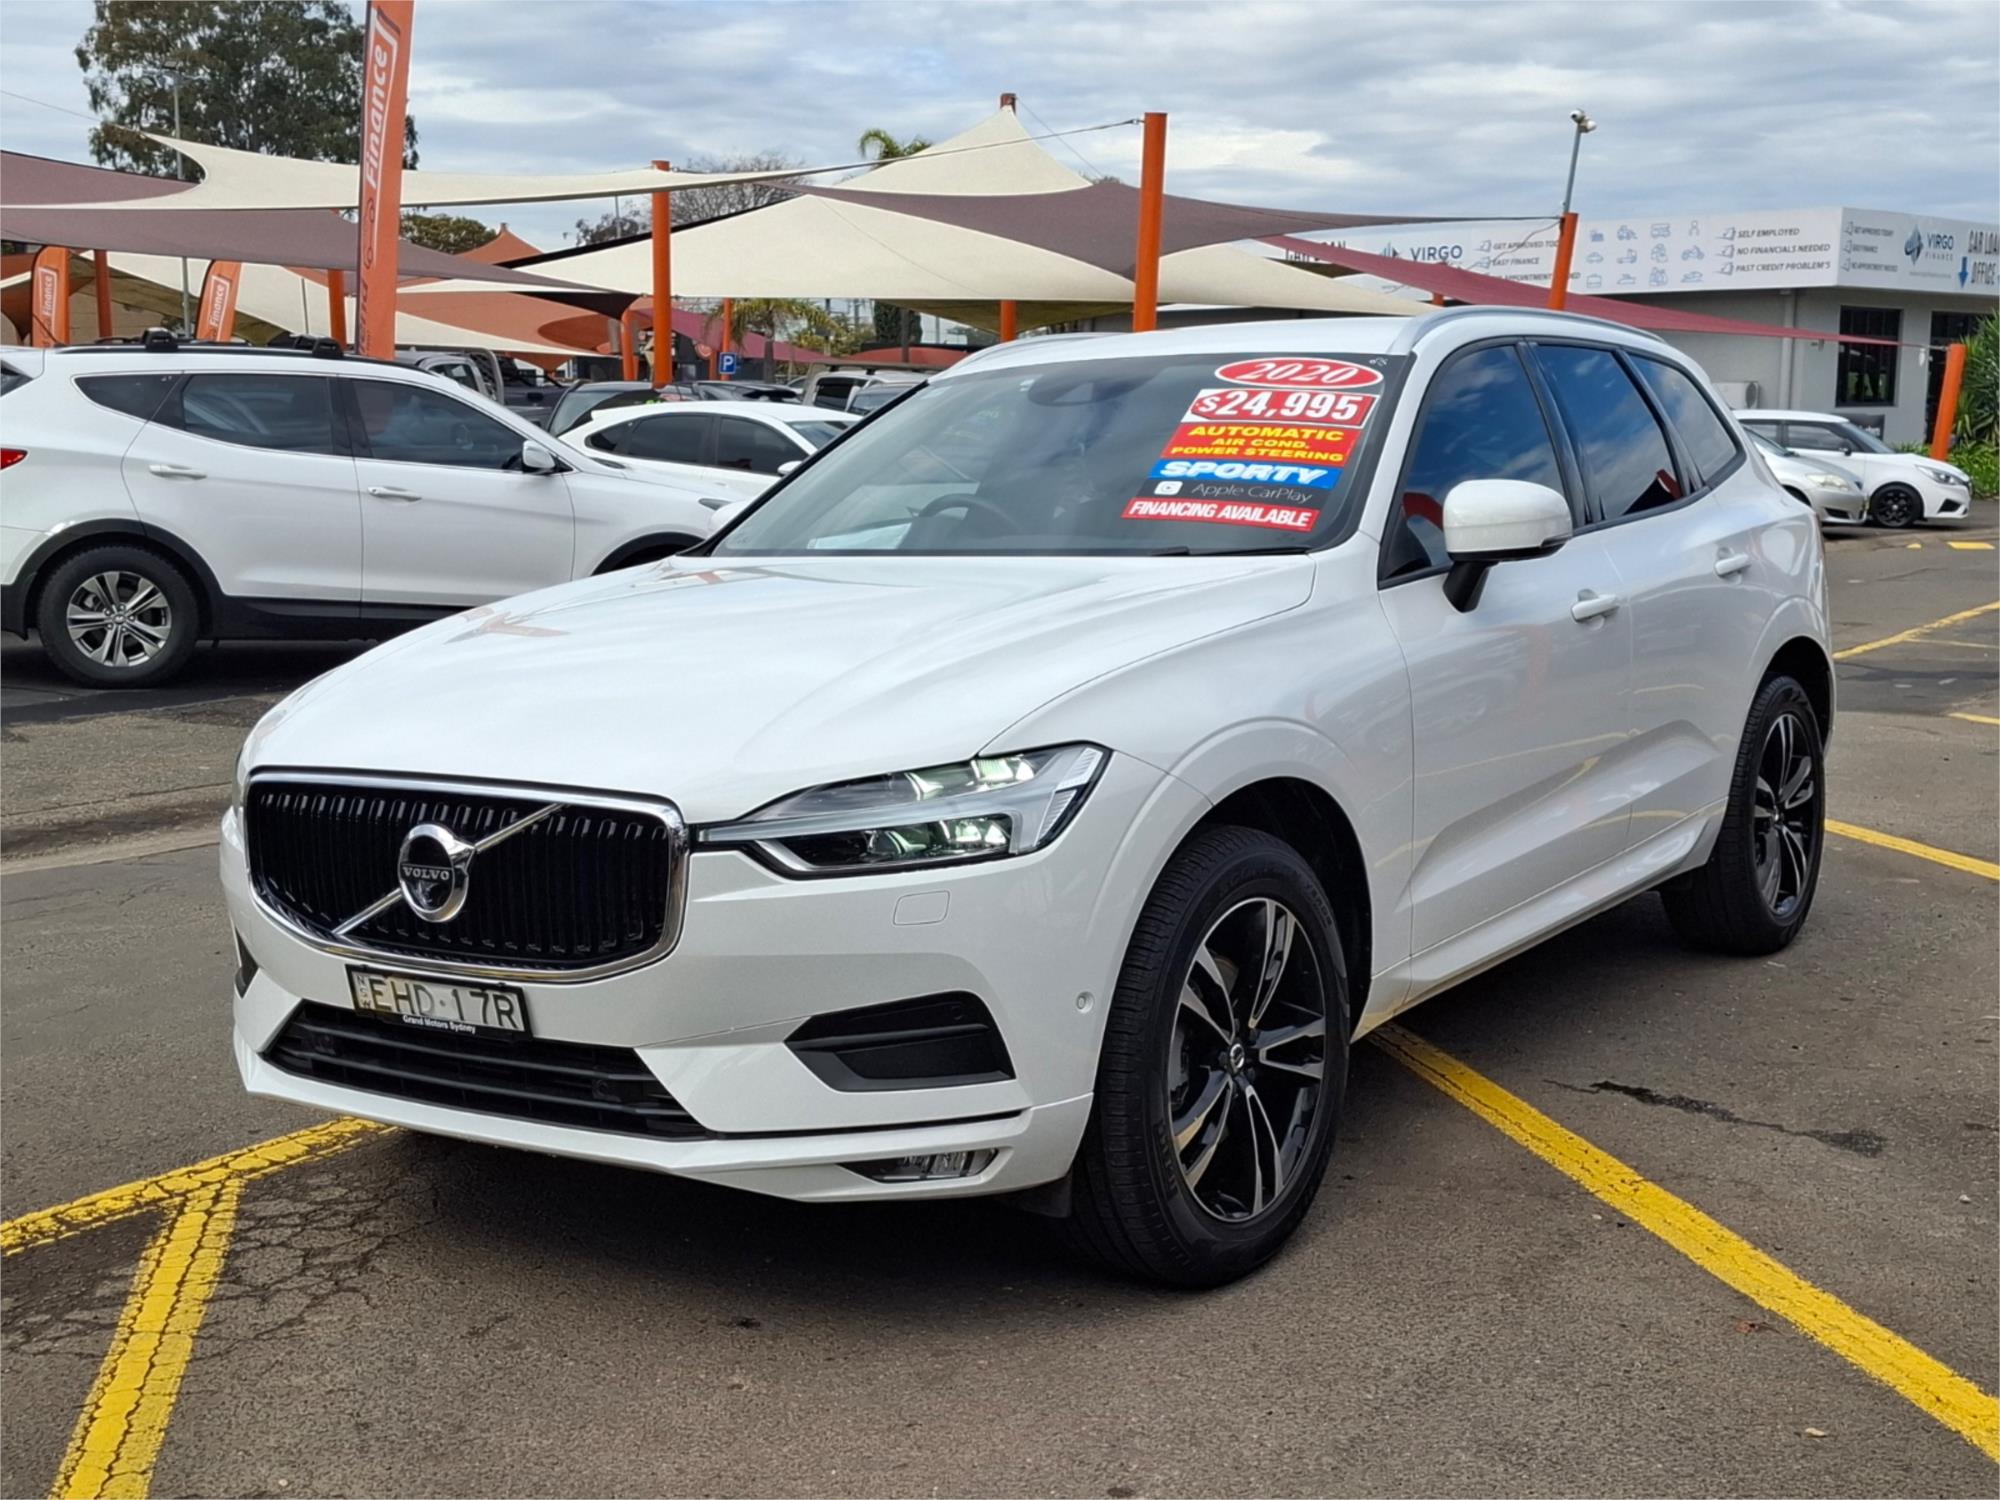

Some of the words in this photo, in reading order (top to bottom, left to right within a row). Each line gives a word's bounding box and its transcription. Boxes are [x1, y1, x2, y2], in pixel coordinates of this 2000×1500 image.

[365, 45, 388, 189] Finance
[1737, 229, 1755, 239] SELF
[1757, 227, 1800, 237] EMPLOYED
[1926, 232, 1954, 250] VIRGO
[1493, 242, 1506, 250] GET
[1737, 247, 1749, 255] NO
[1750, 245, 1796, 255] FINANCIALS
[1797, 243, 1831, 253] NEEDED
[1968, 230, 1983, 254] CAR
[1985, 232, 1999, 255] LOA
[1410, 244, 1463, 262] VIRGO
[1510, 257, 1540, 266] FINANCE
[1736, 264, 1755, 272] PAST
[1756, 263, 1783, 271] CREDIT
[42, 275, 53, 317] Finance
[209, 284, 226, 328] Finance
[723, 355, 734, 371] P
[1236, 362, 1360, 384] 2020
[1198, 390, 1363, 421] $24,995
[1188, 425, 1344, 442] AUTOMATIC
[1212, 438, 1246, 447] AIR
[1251, 439, 1310, 449] COND.
[1170, 446, 1247, 457] POWER
[1252, 447, 1344, 462] STEERING
[1160, 460, 1327, 484] SPORTY
[1192, 483, 1245, 498] Apple
[1248, 484, 1312, 503] CarPlay
[1129, 501, 1215, 518] FINANCING
[1218, 505, 1311, 527] AVAILABLE
[402, 866, 450, 881] VOLVO
[402, 1014, 424, 1026] Grand
[424, 1017, 449, 1030] Motors
[449, 1021, 476, 1035] Sydney
